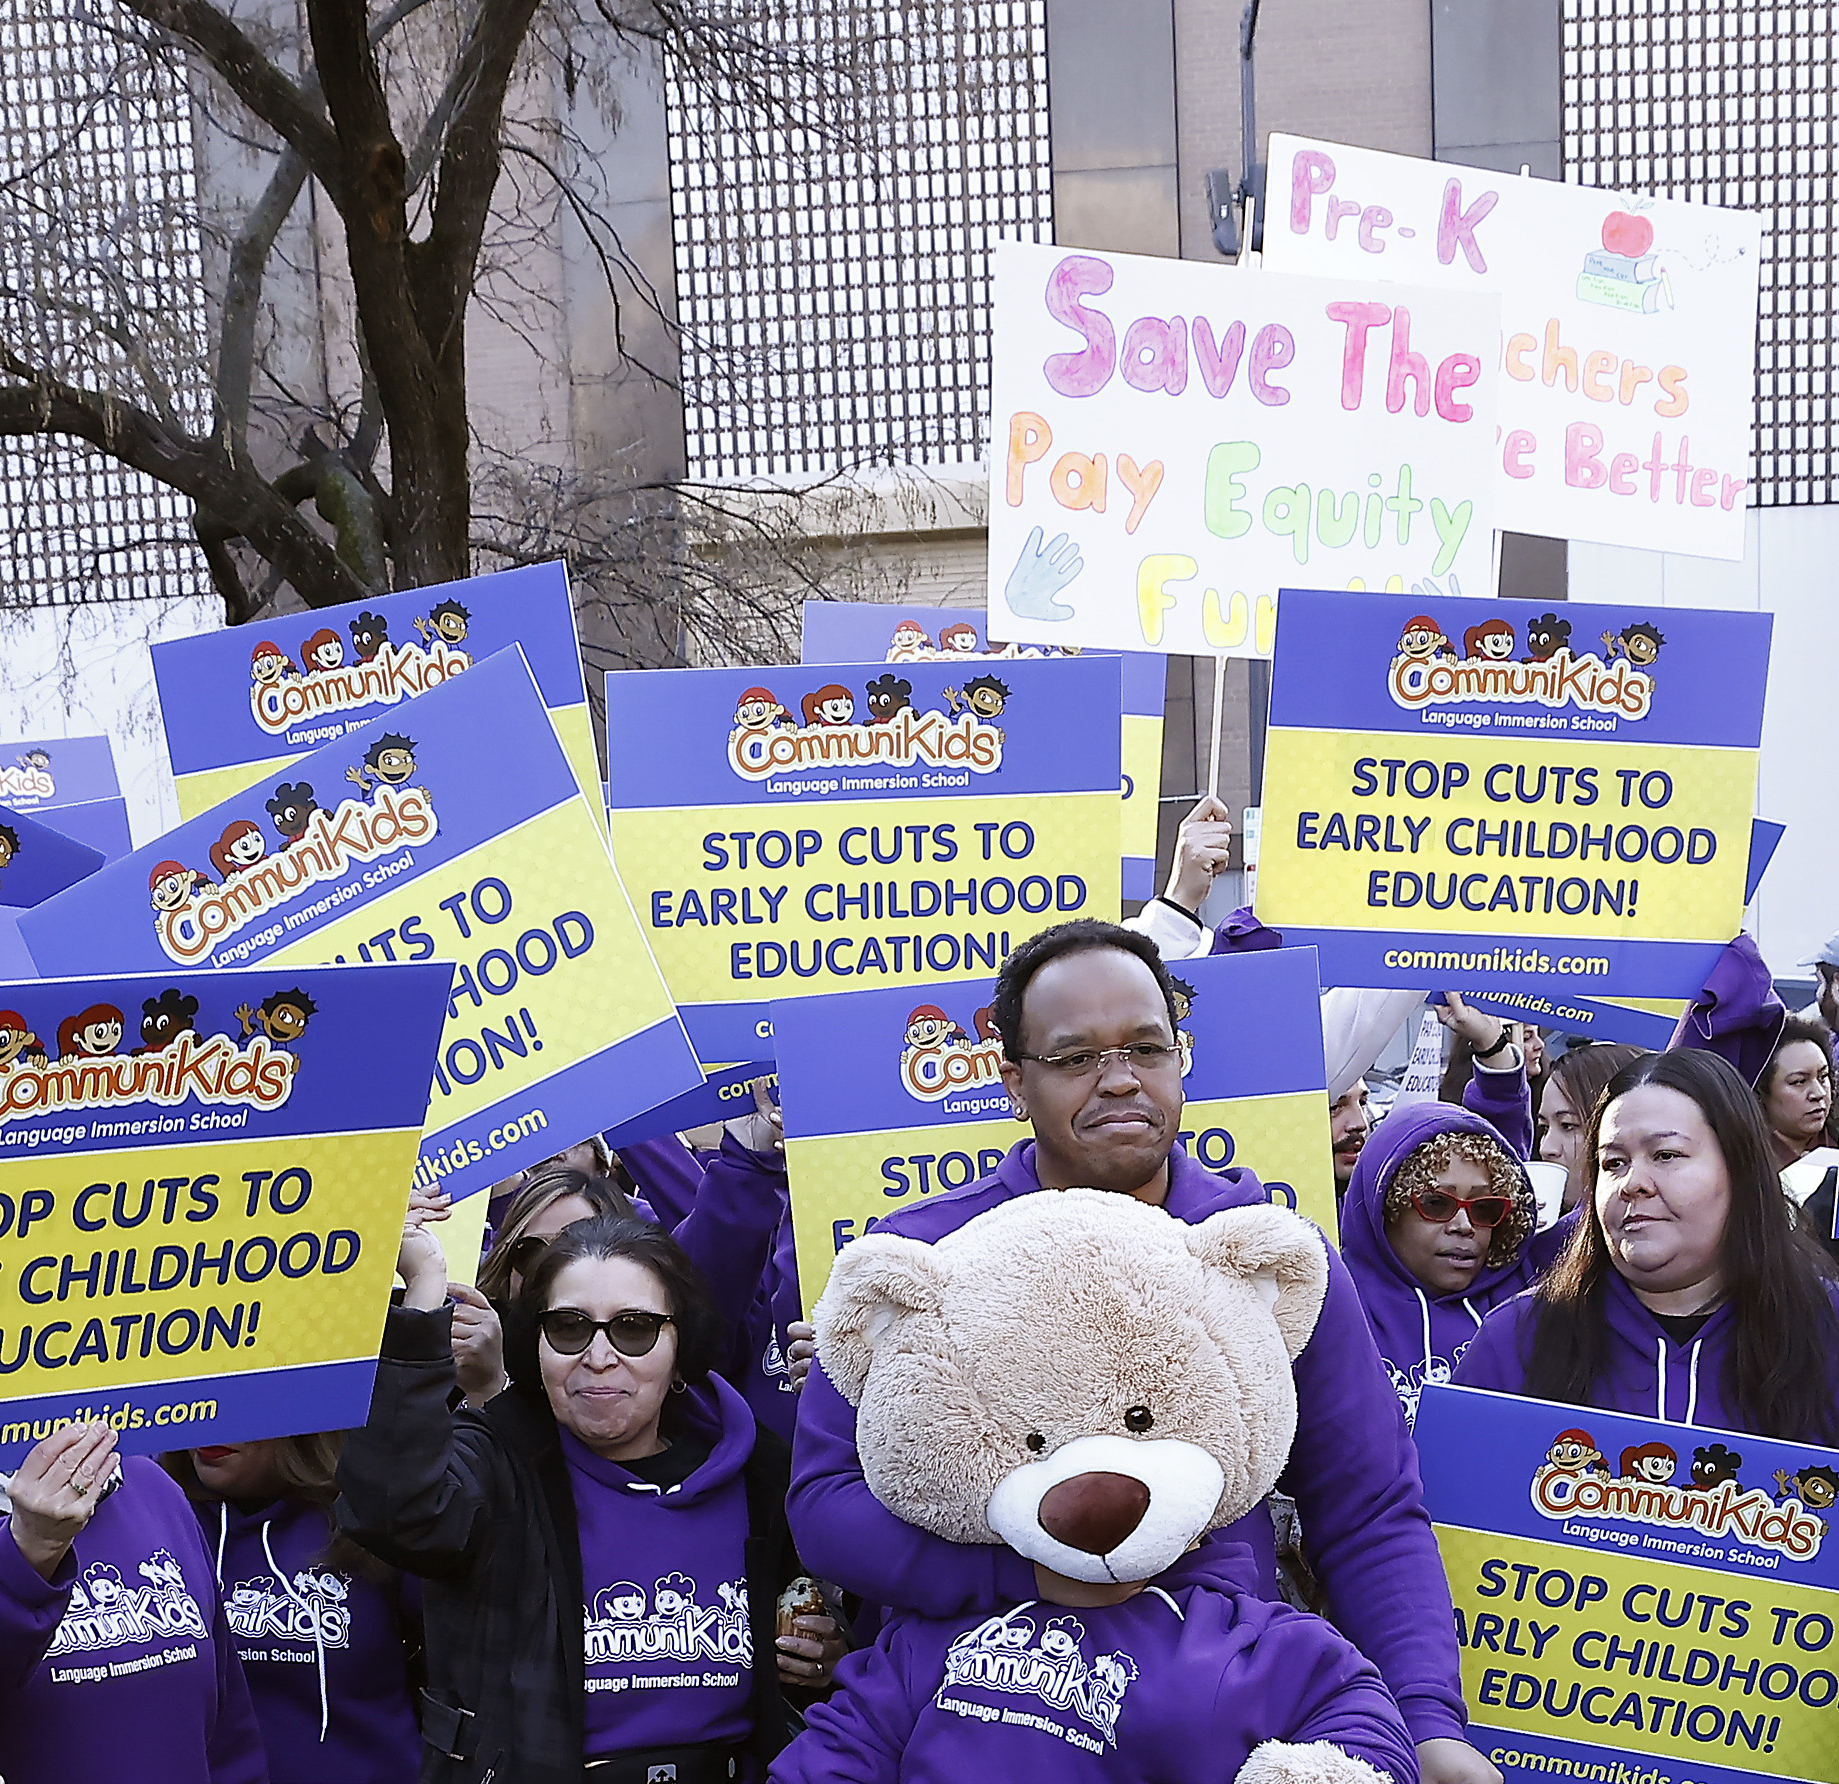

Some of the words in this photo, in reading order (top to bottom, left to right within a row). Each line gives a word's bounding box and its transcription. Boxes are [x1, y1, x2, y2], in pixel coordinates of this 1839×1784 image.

[1290, 148, 1499, 275] Pre-K
[1043, 255, 1294, 407] Save
[1325, 300, 1481, 423] The
[1499, 318, 1690, 417] chers
[1005, 412, 1164, 535] Pay
[1205, 440, 1474, 577] Equity
[1563, 421, 1747, 513] Better
[1393, 652, 1648, 716] CommuniKids
[733, 711, 997, 775] CommuniKids
[1422, 709, 1491, 728] Language
[1494, 712, 1567, 729] Immersion
[1570, 716, 1617, 731] School
[766, 779, 838, 795] Language
[841, 776, 918, 790] Immersion
[921, 771, 969, 787] School
[1352, 757, 1470, 800] STOP
[1484, 763, 1598, 806] CUTS
[1616, 769, 1673, 809] TO
[703, 829, 823, 872] STOP
[838, 823, 957, 866] CUTS
[974, 821, 1035, 860] TO
[1297, 811, 1431, 854] EARLY
[1445, 817, 1718, 865] CHILDHOOD
[163, 792, 431, 959] CommuniKids
[652, 885, 788, 928] EARLY
[805, 874, 1087, 922] CHILDHOOD
[1367, 869, 1639, 918] EDUCATION!
[1384, 948, 1608, 975] communikids.com
[91, 1118, 185, 1138] Immersion
[189, 1109, 248, 1130] School
[73, 1174, 220, 1232] CUTS
[242, 1166, 313, 1216] TO
[19, 1229, 362, 1304] CHILDHOOD
[1536, 1465, 1819, 1557] CommuniKids
[1562, 1520, 1639, 1546] Language
[1642, 1533, 1724, 1560] Immersion
[1727, 1548, 1780, 1569] School
[1477, 1559, 1608, 1612] STOP
[1622, 1583, 1751, 1638] CUTS
[1770, 1607, 1834, 1652] TO
[51, 1665, 108, 1684] Language
[109, 1654, 163, 1679] Immersion
[163, 1644, 198, 1665] School
[271, 1648, 316, 1664] School
[631, 1672, 700, 1689] Immersion
[701, 1671, 739, 1687] School
[936, 1695, 1001, 1723] Language
[1001, 1706, 1064, 1739] Immersion
[1065, 1726, 1105, 1757] School
[1479, 1668, 1781, 1753] EDUCATION!
